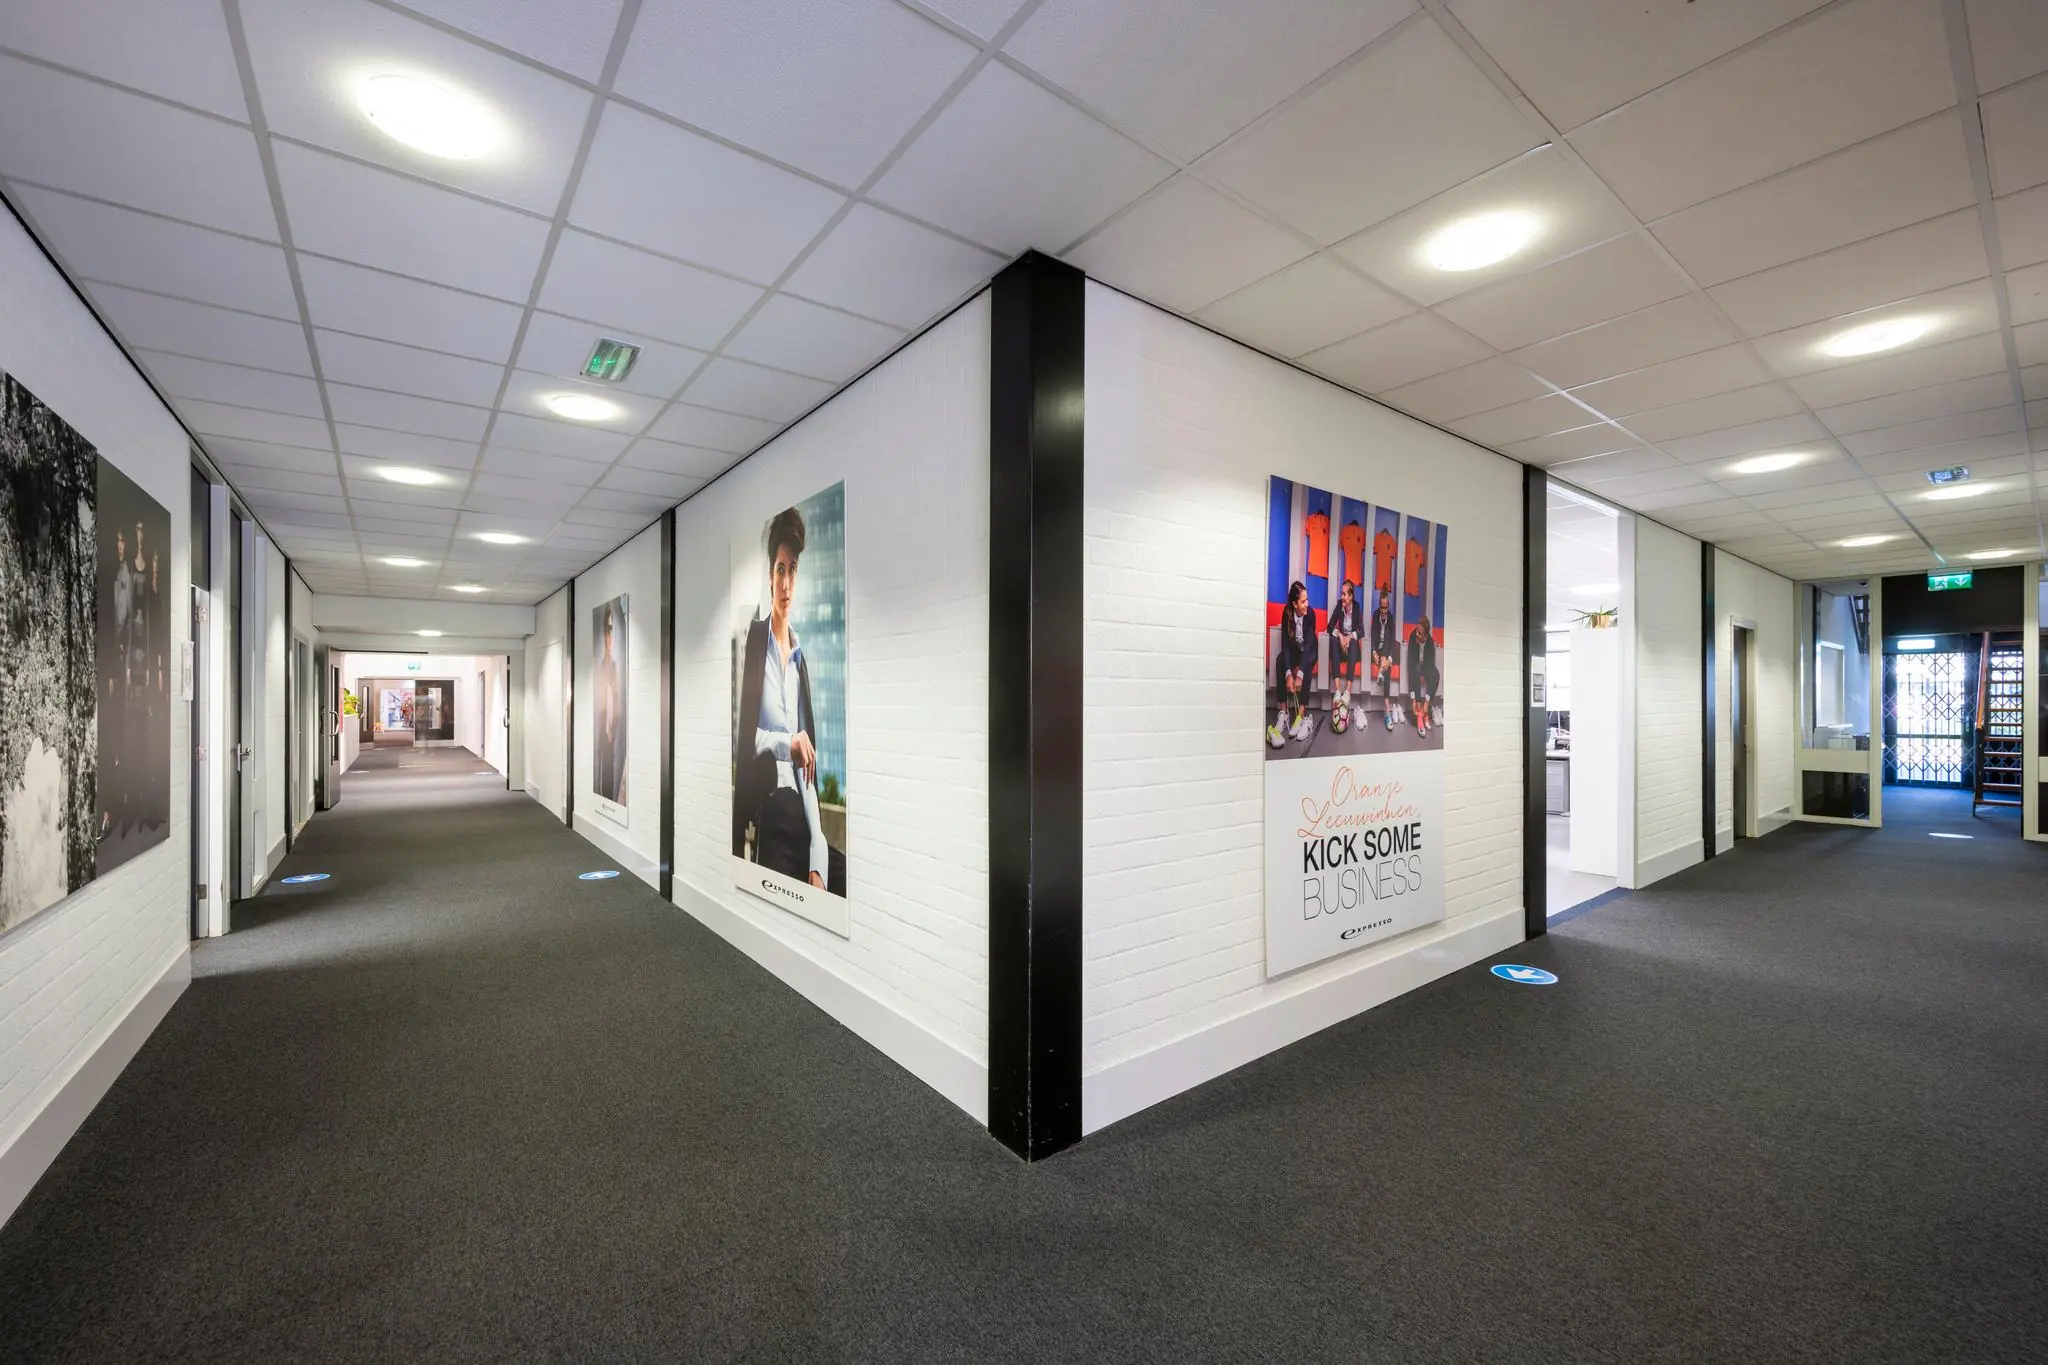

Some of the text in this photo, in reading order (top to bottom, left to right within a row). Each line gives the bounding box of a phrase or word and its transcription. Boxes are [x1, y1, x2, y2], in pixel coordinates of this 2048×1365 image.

[1331, 766, 1403, 812] Oranje
[1304, 822, 1421, 873] KICK SOME
[1304, 855, 1421, 920] BUSINESS
